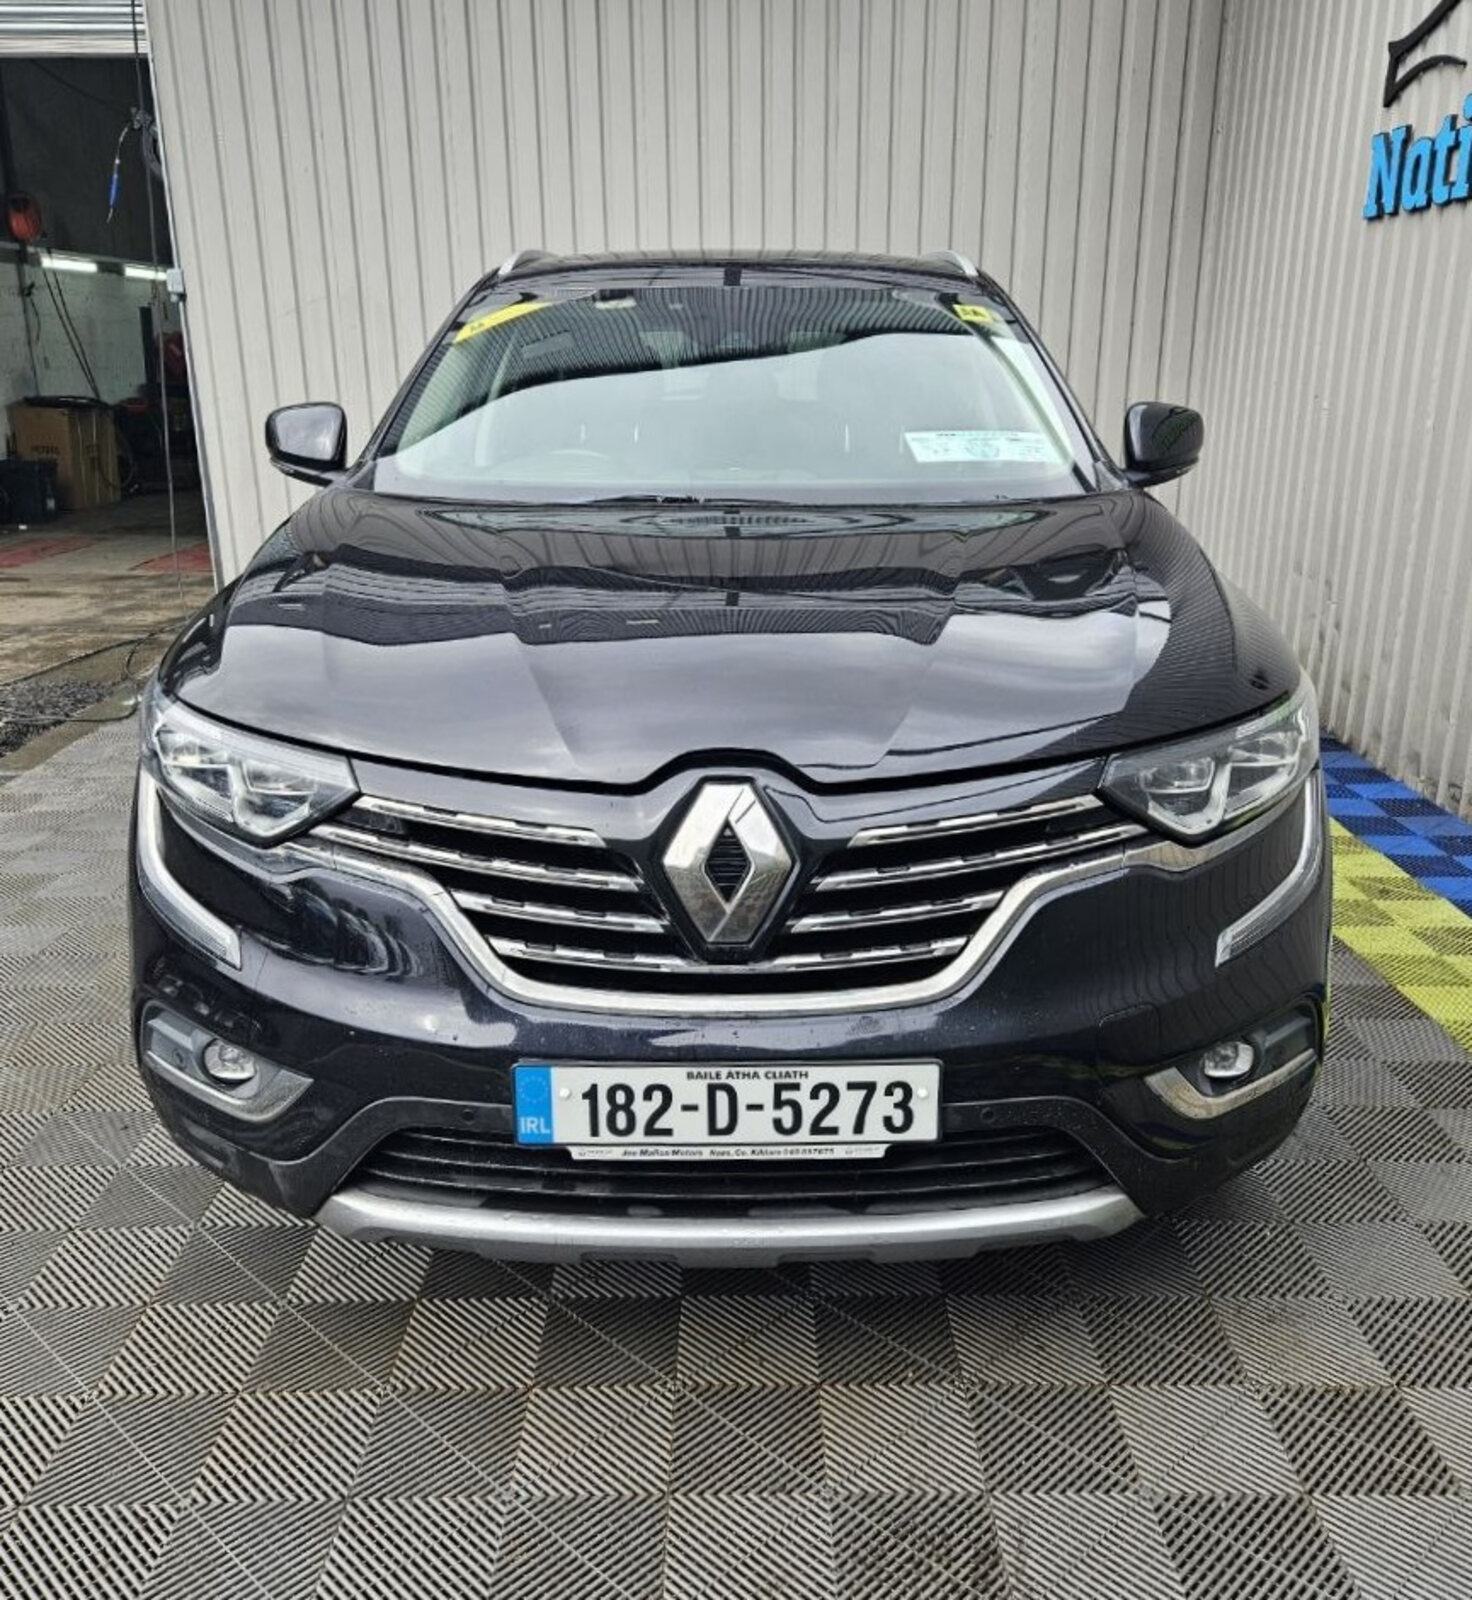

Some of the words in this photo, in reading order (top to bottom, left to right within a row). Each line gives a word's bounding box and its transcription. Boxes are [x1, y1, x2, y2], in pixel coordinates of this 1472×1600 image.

[1363, 93, 1472, 219] Nati
[686, 1070, 722, 1080] BAILE
[764, 1070, 809, 1080] CLIATH
[520, 1116, 551, 1134] IRL
[581, 1080, 914, 1138] 182-D-5273
